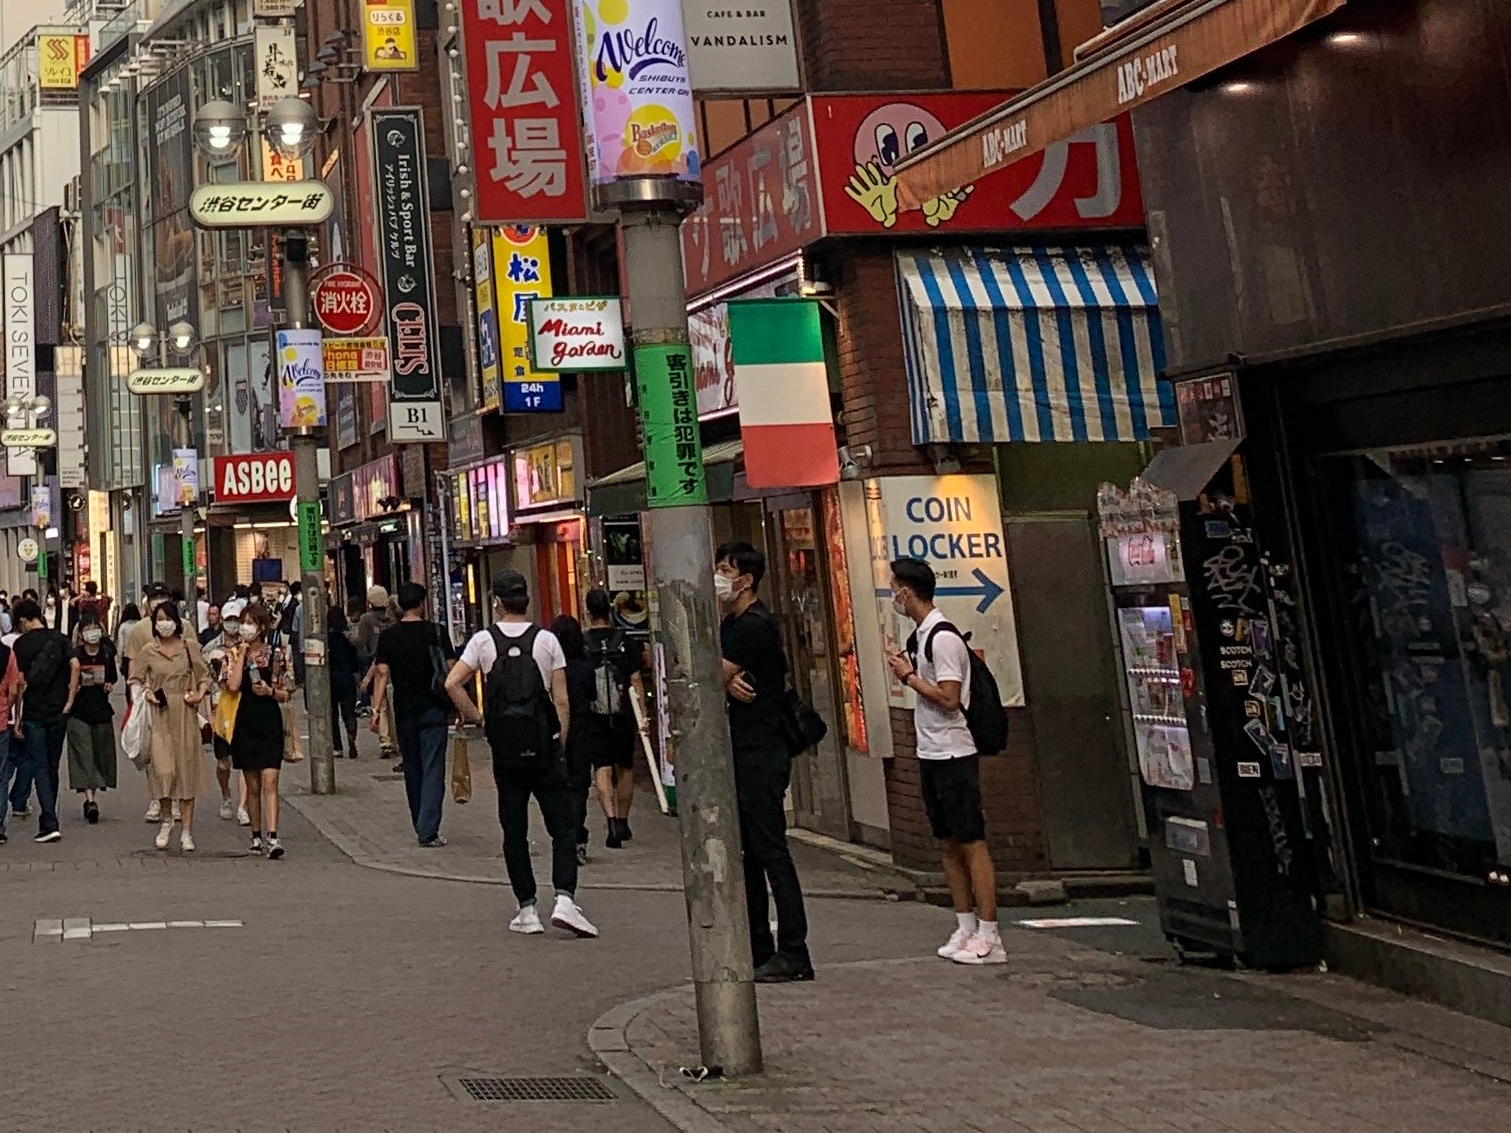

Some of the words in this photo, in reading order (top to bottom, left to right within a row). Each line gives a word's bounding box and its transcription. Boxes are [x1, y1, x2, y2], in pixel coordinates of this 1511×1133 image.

[706, 9, 734, 19] CAFE
[746, 9, 767, 19] BAR
[596, 17, 688, 82] Welcome
[689, 33, 789, 47] VANDALISM
[637, 73, 687, 83] SHIBUYA
[397, 153, 412, 189] Irish
[198, 192, 325, 213] 渋谷センター街
[400, 202, 415, 244] Sport
[403, 245, 418, 268] Bar
[10, 271, 29, 324] TOKI
[320, 291, 368, 315] 消火栓
[538, 318, 605, 338] Miami
[520, 383, 544, 393] 24h
[407, 407, 428, 423] B1
[665, 352, 699, 496] 客引きは犯罪です
[905, 496, 972, 525] COIN
[891, 532, 1003, 562] LOCKER
